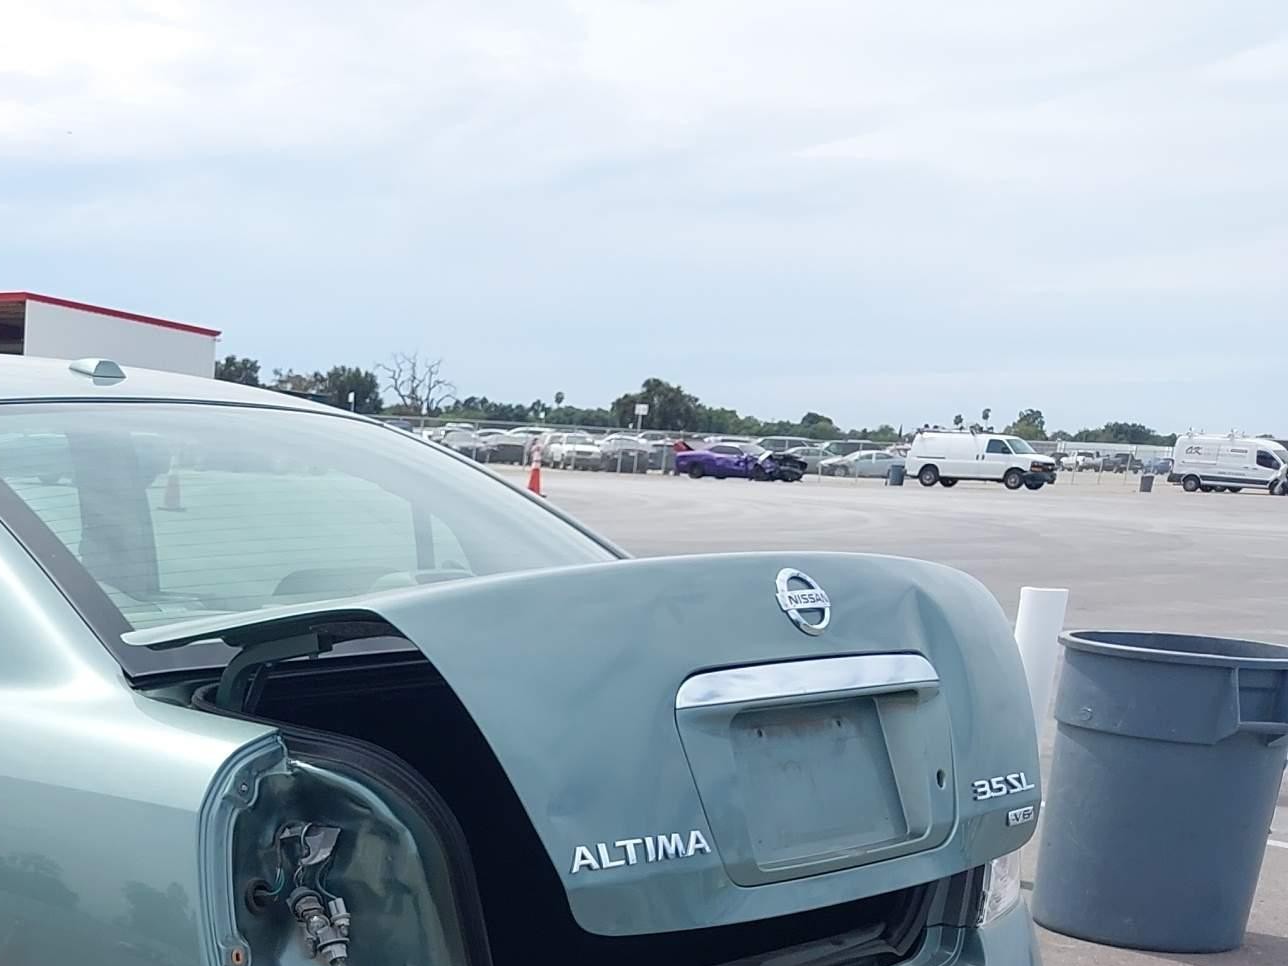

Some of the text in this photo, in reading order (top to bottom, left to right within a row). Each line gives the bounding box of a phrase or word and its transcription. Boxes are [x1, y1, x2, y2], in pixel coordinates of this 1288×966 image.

[787, 593, 829, 605] NISSAN
[1014, 809, 1032, 822] V6
[570, 830, 712, 874] ALTIMA
